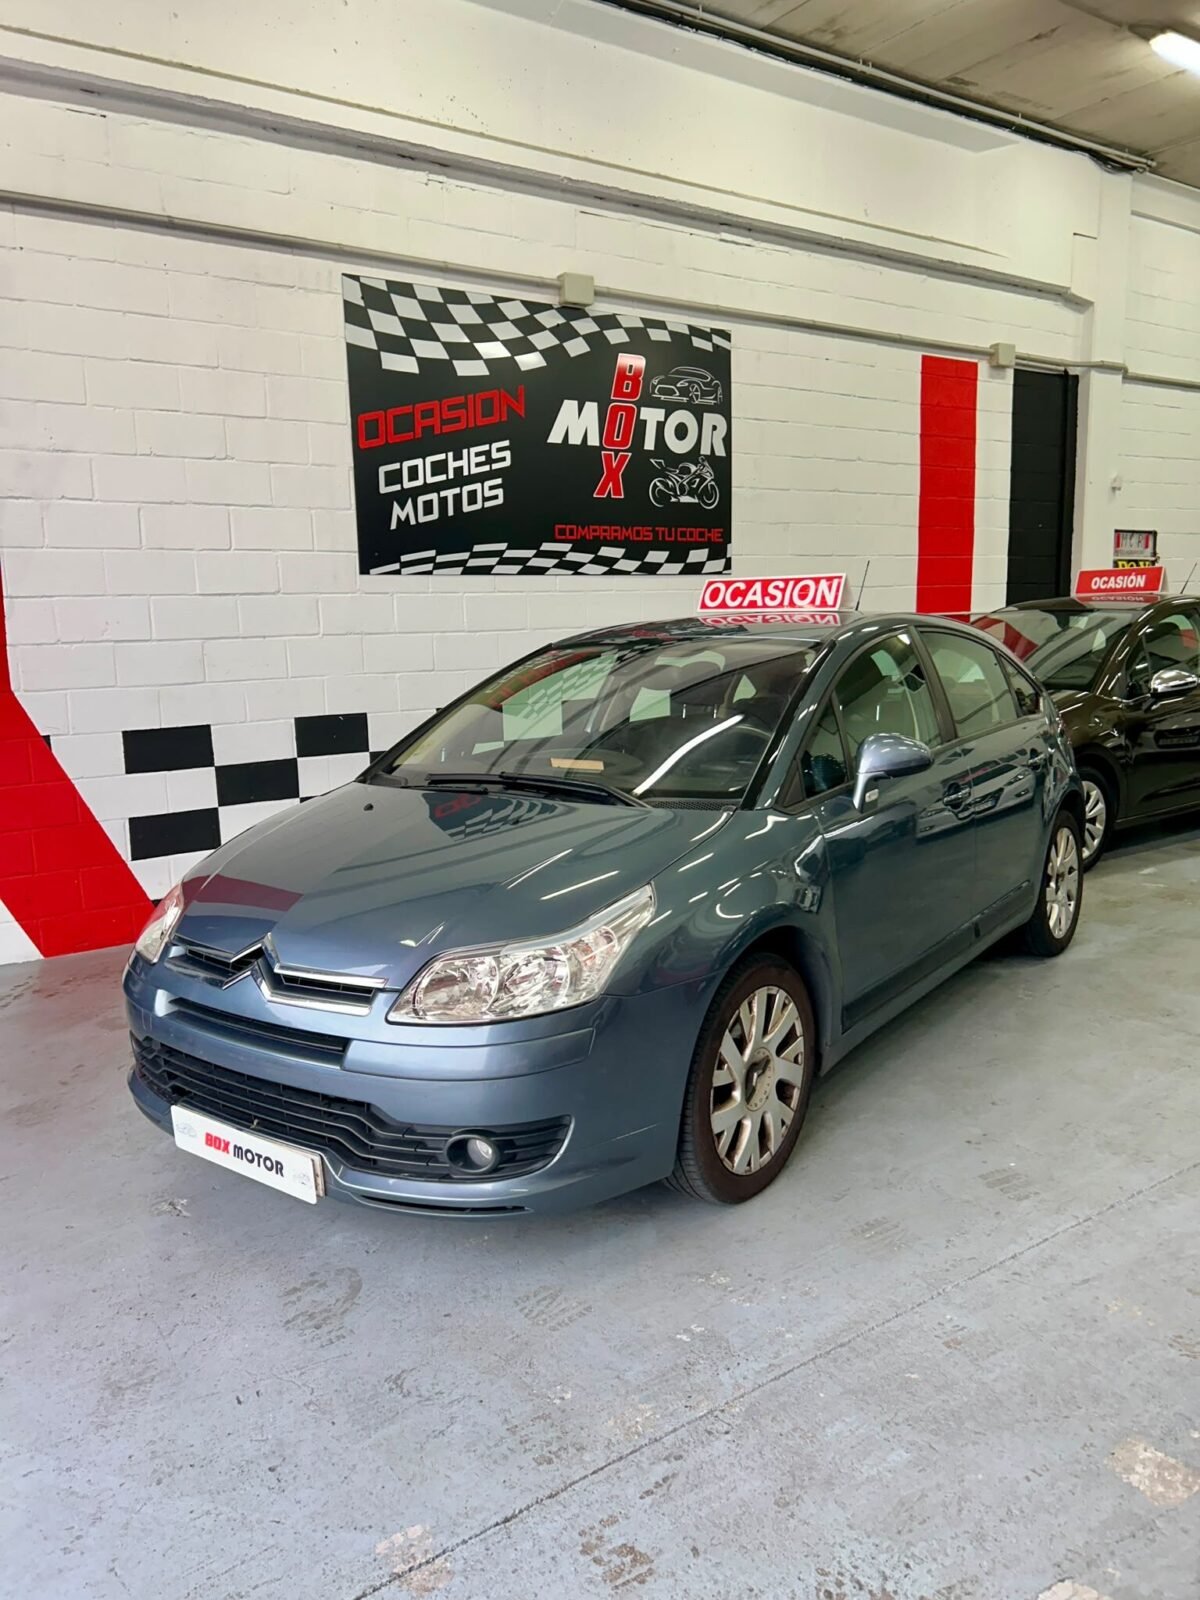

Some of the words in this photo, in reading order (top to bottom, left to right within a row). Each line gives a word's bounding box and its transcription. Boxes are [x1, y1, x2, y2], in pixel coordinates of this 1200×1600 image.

[357, 385, 526, 449] OCASION
[593, 353, 646, 499] BOX
[378, 440, 511, 494] COCHES
[390, 478, 504, 530] MOTOS
[555, 524, 653, 541] COMPRAMOS
[655, 527, 675, 541] TU
[677, 527, 724, 542] COCHE
[703, 578, 839, 608] OCASION
[1091, 572, 1146, 590] OCASIÓN
[205, 1131, 231, 1155] BOX
[233, 1144, 285, 1178] MOTOR
